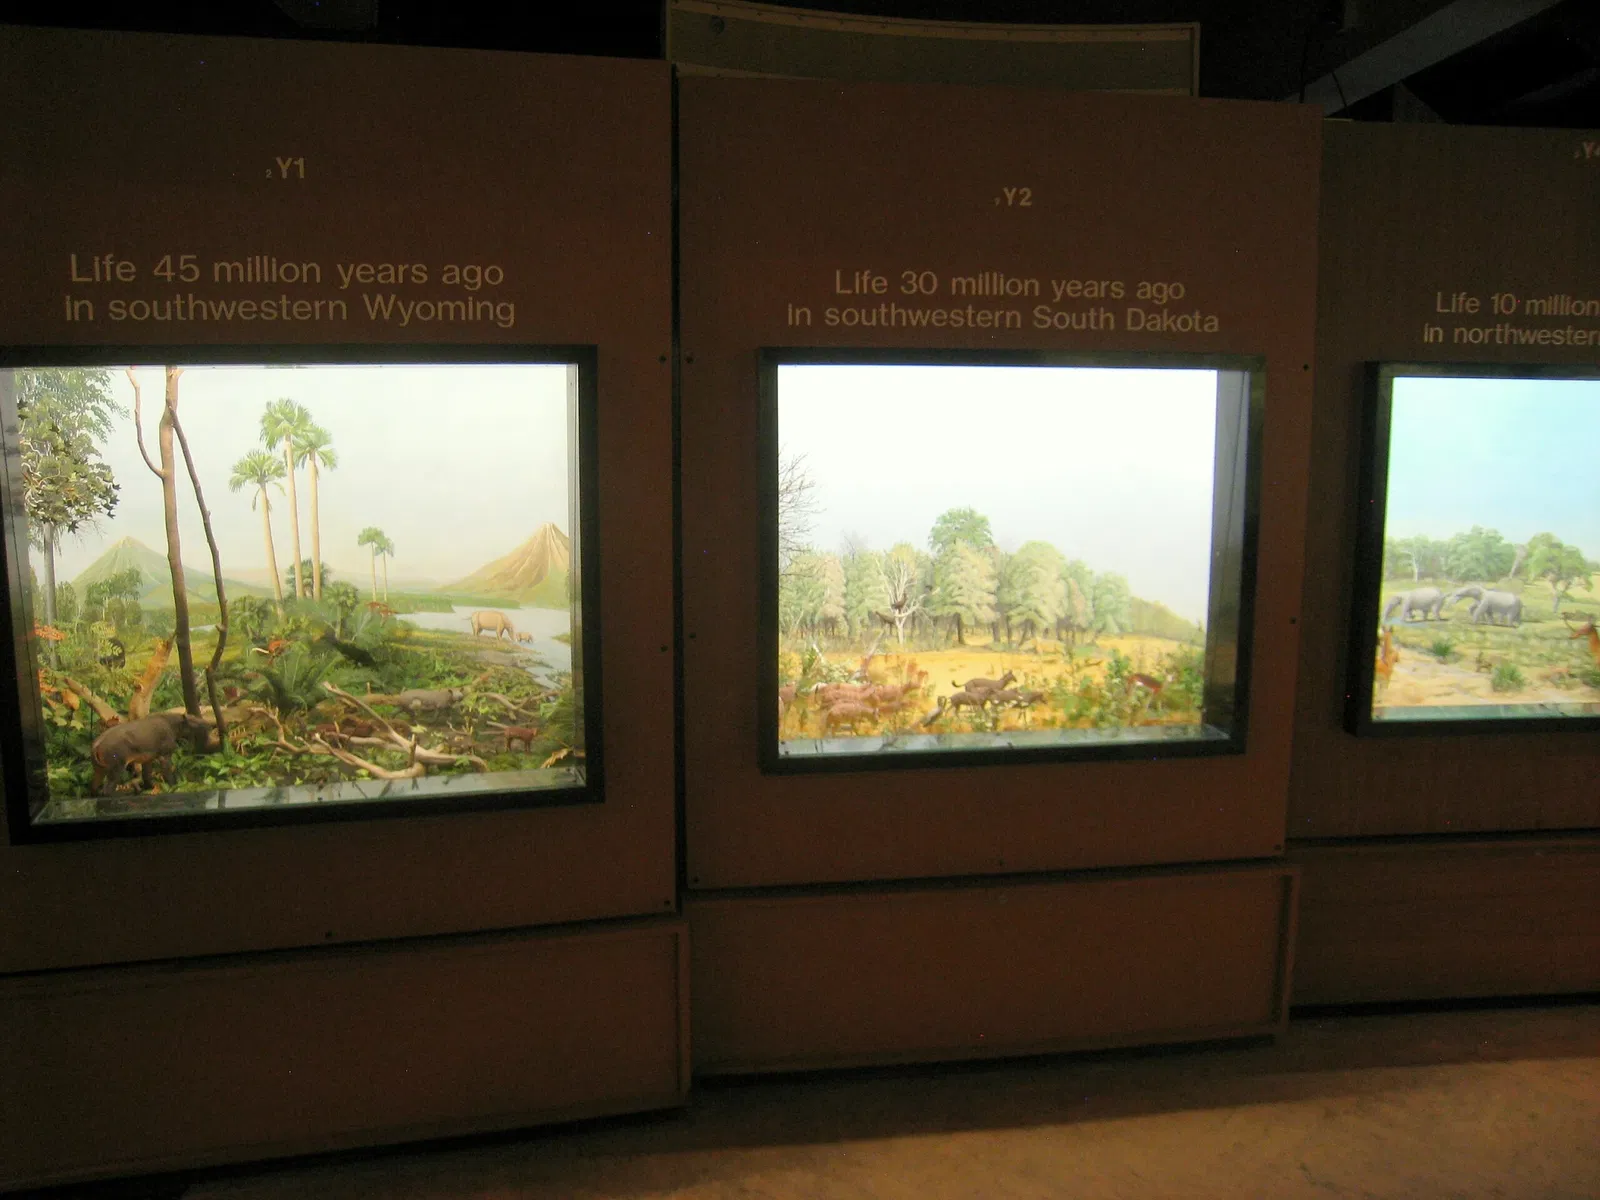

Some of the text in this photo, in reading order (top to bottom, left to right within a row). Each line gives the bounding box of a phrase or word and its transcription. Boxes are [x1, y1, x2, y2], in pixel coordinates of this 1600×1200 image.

[70, 253, 505, 291] Life 45 million years ago
[835, 269, 1186, 305] Life 30 million years ago
[108, 293, 348, 321] southwestern
[362, 293, 516, 328] Wyoming
[824, 302, 1022, 329] southwestern
[1032, 305, 1116, 331] South
[1126, 307, 1220, 333] Dakota
[1435, 291, 1600, 317] Life 10 million
[1453, 322, 1600, 346] northwester
